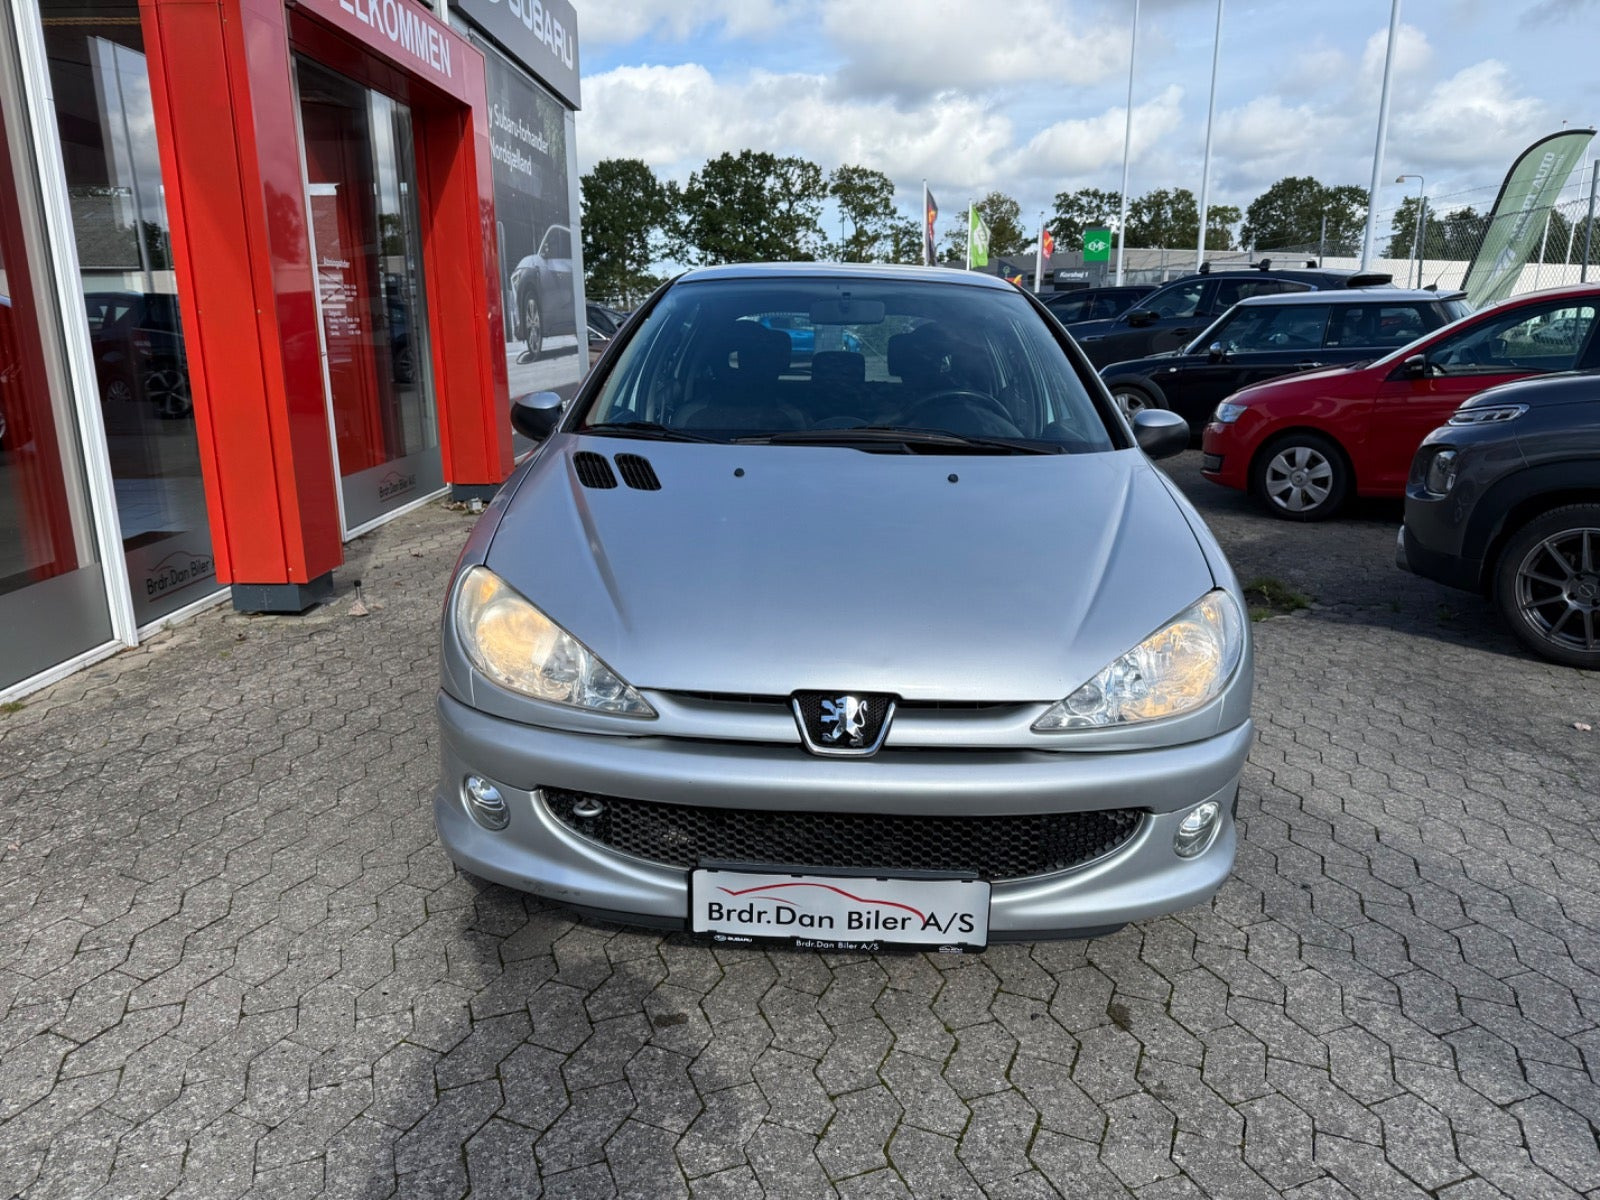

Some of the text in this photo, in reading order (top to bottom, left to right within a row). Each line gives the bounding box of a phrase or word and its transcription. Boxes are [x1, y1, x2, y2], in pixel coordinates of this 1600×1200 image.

[339, 0, 452, 78] LKOMMEN
[708, 902, 974, 934] Brdr.Dan Biler A/S
[727, 935, 753, 943] SUBARU
[795, 940, 880, 951] Brdr.Dan Biler A/S
